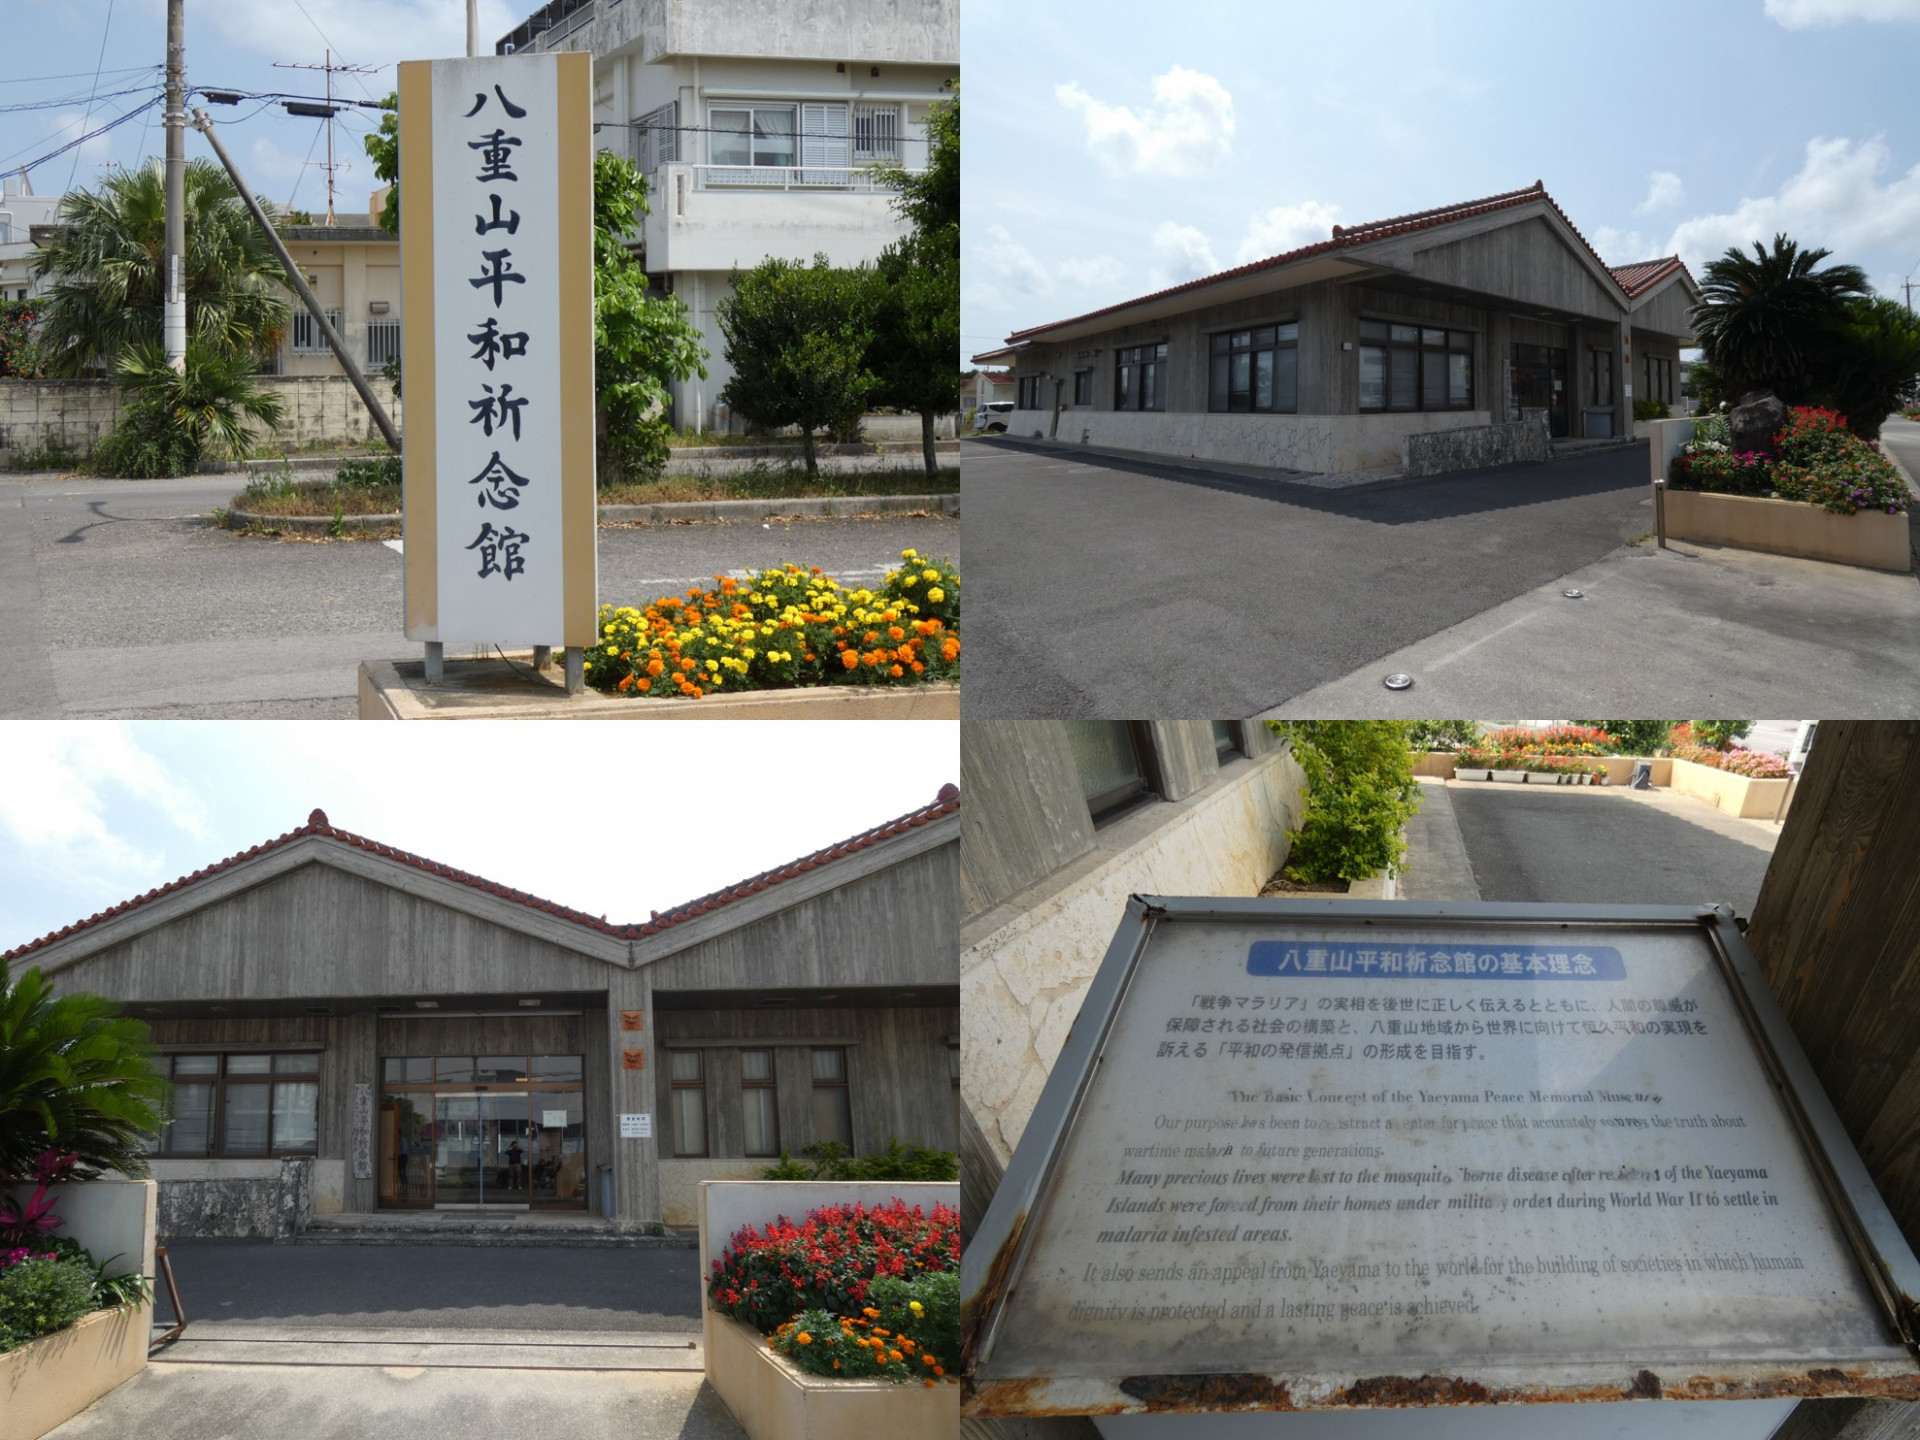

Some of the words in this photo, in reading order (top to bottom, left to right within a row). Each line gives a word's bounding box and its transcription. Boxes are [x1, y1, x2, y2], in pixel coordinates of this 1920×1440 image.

[463, 84, 530, 582] 八重山平和祈念館
[1278, 948, 1597, 975] 八重山平和祈念館の基本理念
[1227, 1090, 1259, 1103] The
[1264, 1087, 1302, 1103] Basic
[1372, 1090, 1389, 1103] of
[1391, 1090, 1413, 1103] the
[1419, 1090, 1479, 1106] Yaeyama
[1484, 1090, 1524, 1103] Peace
[1529, 1089, 1594, 1103] Memorial
[1154, 1114, 1182, 1130] Our
[1184, 1118, 1239, 1133] purpose
[1269, 1115, 1300, 1130] been
[1304, 1117, 1317, 1130] to
[1385, 1118, 1393, 1130] a
[1395, 1116, 1435, 1131] enter
[1501, 1114, 1528, 1129] that
[1532, 1115, 1597, 1133] accurately
[1651, 1114, 1672, 1129] the
[1675, 1114, 1709, 1128] truth
[1711, 1114, 1747, 1128] about
[1123, 1143, 1180, 1159] wartime
[1240, 1144, 1253, 1157] to
[1257, 1142, 1299, 1158] future
[1115, 1170, 1161, 1188] Many
[1162, 1169, 1230, 1188] precious
[1232, 1169, 1266, 1185] lives
[1270, 1172, 1305, 1185] were
[1308, 1168, 1336, 1184] lost
[1339, 1170, 1353, 1184] to
[1357, 1168, 1380, 1184] the
[1507, 1166, 1558, 1182] disease
[1664, 1165, 1678, 1183] of
[1681, 1165, 1702, 1181] the
[1704, 1165, 1769, 1183] Yaeyama
[1105, 1197, 1165, 1214] Islands
[1169, 1202, 1205, 1214] were
[1258, 1196, 1298, 1216] from
[1302, 1195, 1341, 1212] their
[1343, 1195, 1392, 1212] homes
[1396, 1195, 1442, 1211] under
[1447, 1193, 1508, 1213] militay
[1557, 1192, 1606, 1212] during
[1609, 1191, 1652, 1208] World
[1655, 1191, 1684, 1207] War
[1723, 1190, 1760, 1207] settle
[1762, 1190, 1779, 1206] in
[1096, 1225, 1169, 1244] malaria
[1171, 1225, 1240, 1248] infested
[1242, 1226, 1293, 1244] areas.
[1082, 1262, 1099, 1282] It
[1101, 1262, 1133, 1282] also
[1138, 1262, 1183, 1282] sends
[1187, 1267, 1209, 1282] an
[1212, 1260, 1266, 1285] appeal
[1270, 1260, 1308, 1281] from
[1311, 1259, 1380, 1283] Yaeyama
[1385, 1261, 1400, 1277] to
[1405, 1258, 1429, 1276] the
[1437, 1256, 1479, 1276] world
[1483, 1256, 1505, 1275] for
[1509, 1256, 1534, 1275] the
[1536, 1255, 1600, 1277] building
[1602, 1254, 1617, 1273] of
[1621, 1253, 1683, 1272] societies
[1685, 1253, 1702, 1271] in
[1705, 1252, 1750, 1271] which
[1750, 1252, 1805, 1270] human
[1067, 1300, 1127, 1323] dignity
[1131, 1299, 1146, 1321] is
[1148, 1298, 1227, 1324] protected
[1230, 1299, 1261, 1320] and
[1265, 1303, 1275, 1319] a
[1280, 1297, 1336, 1321] lasting
[1340, 1302, 1384, 1322] peace
